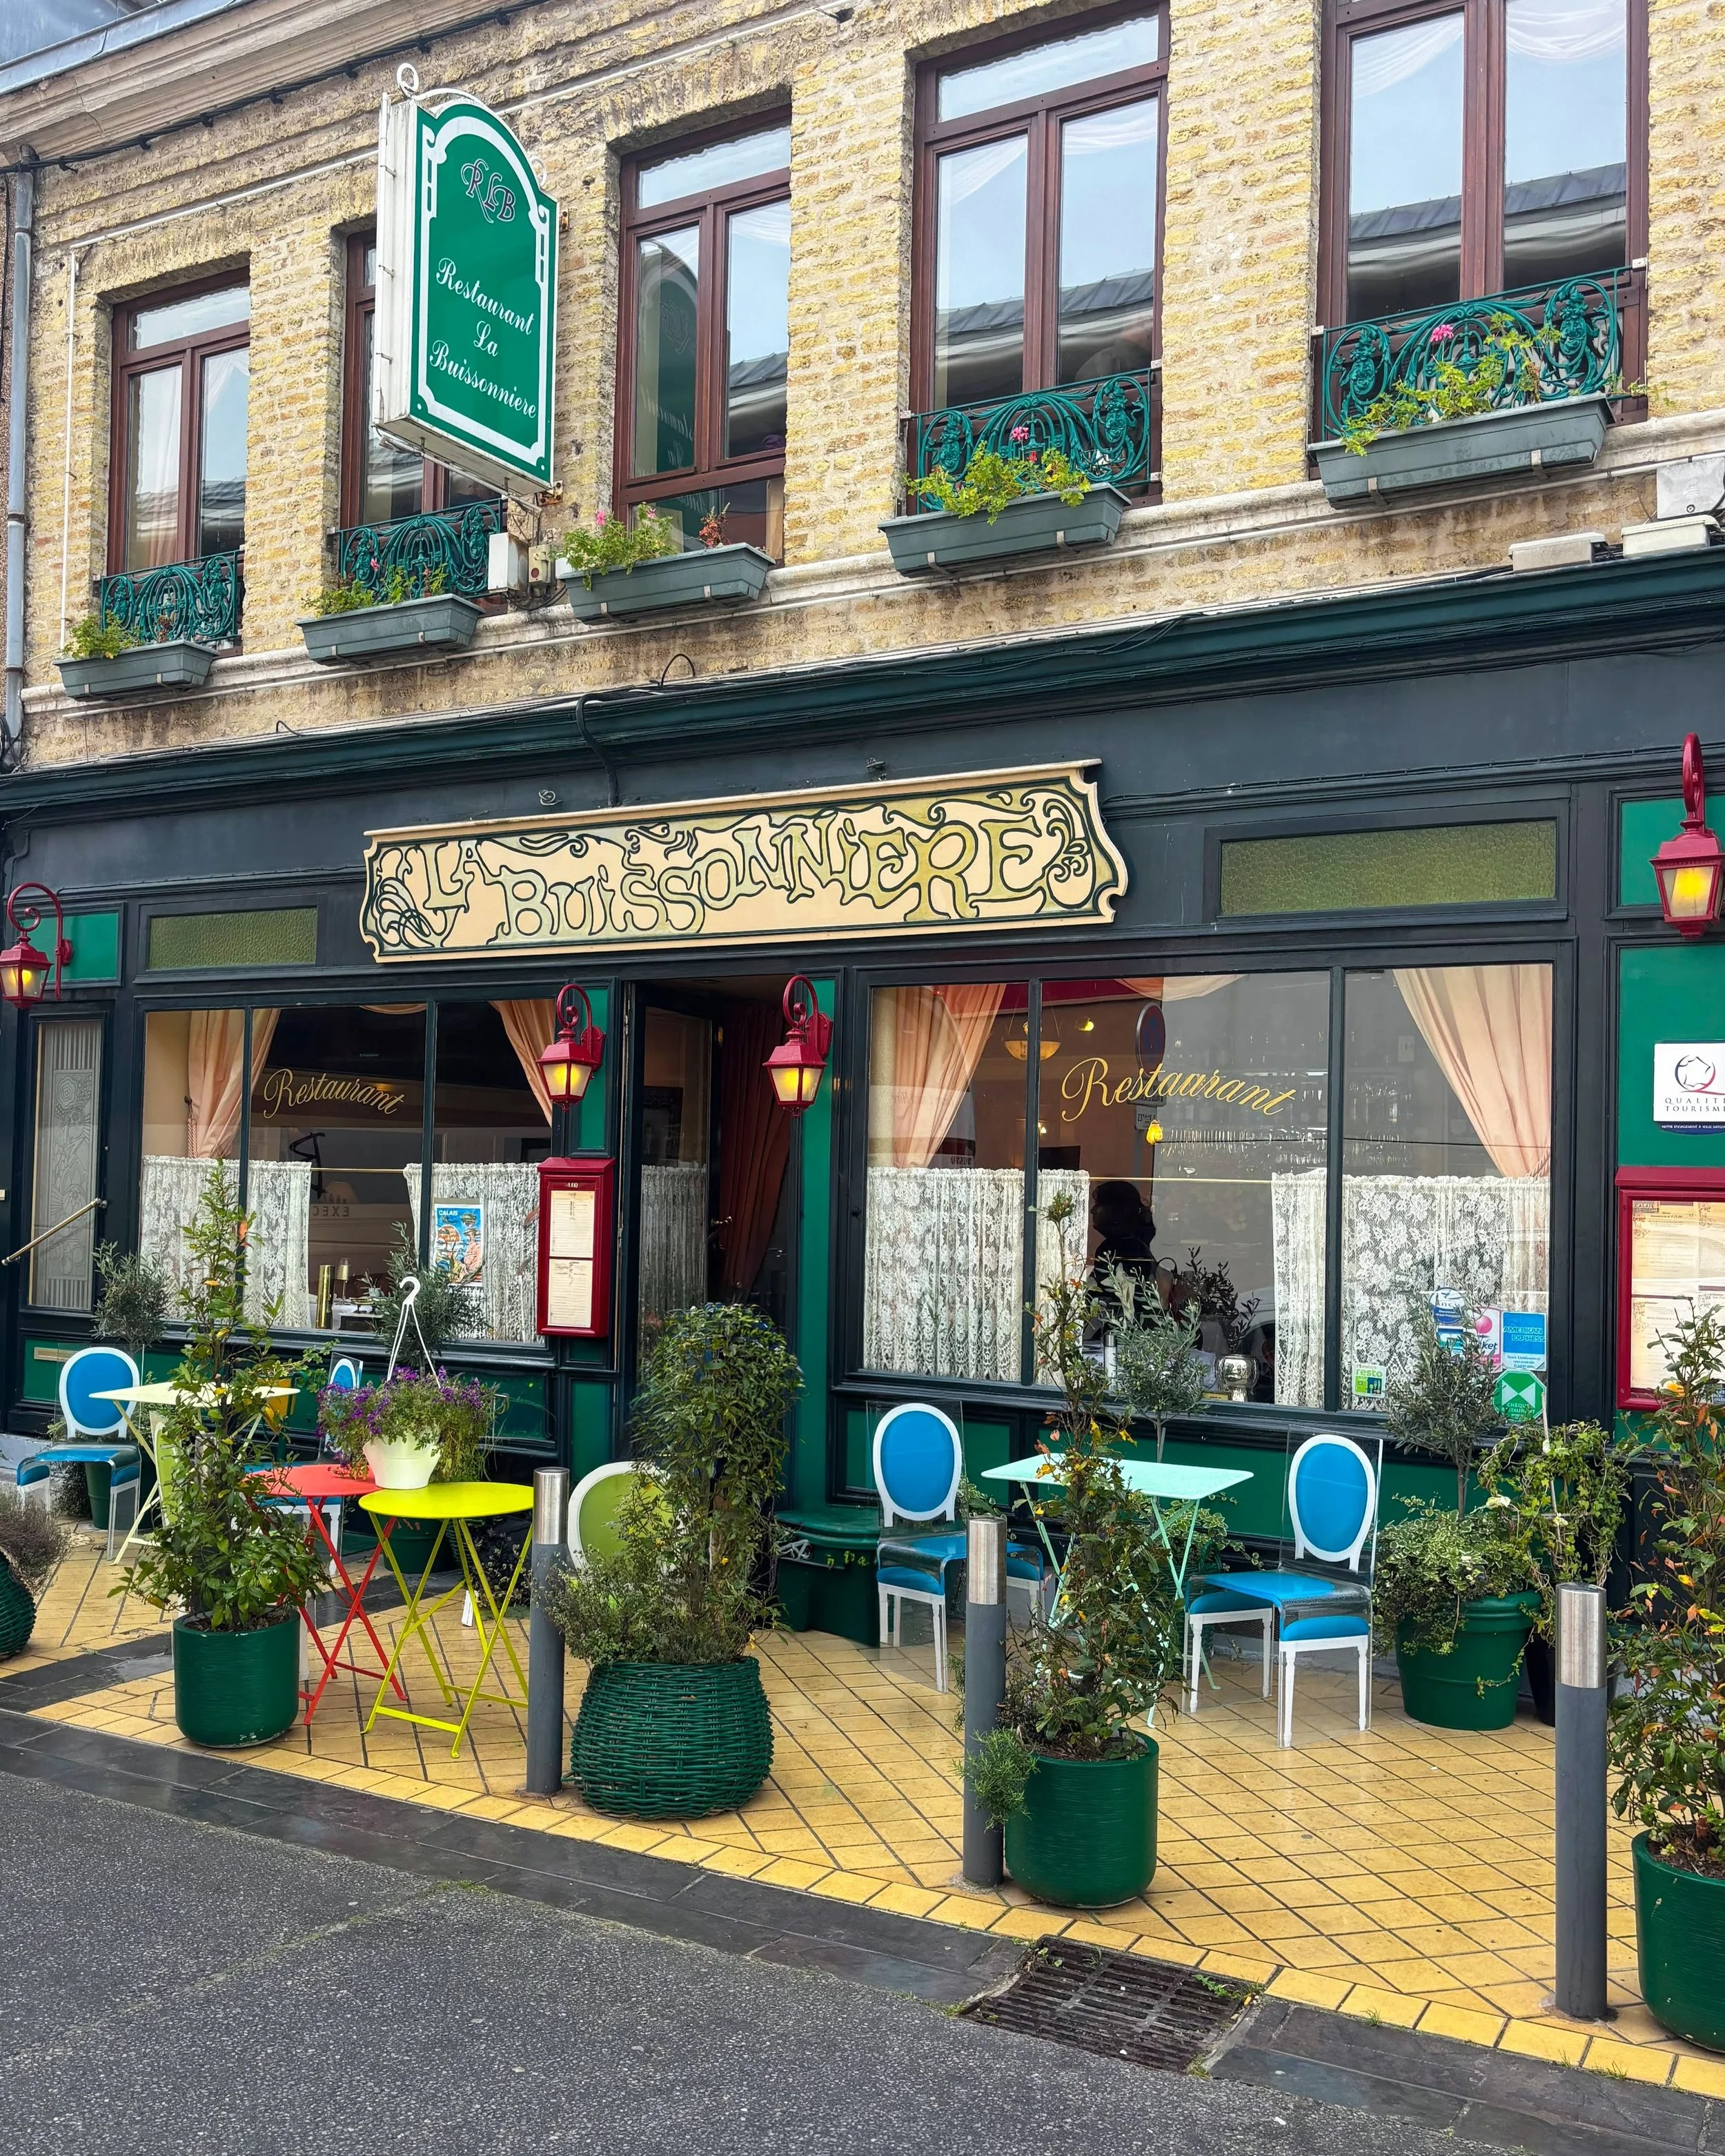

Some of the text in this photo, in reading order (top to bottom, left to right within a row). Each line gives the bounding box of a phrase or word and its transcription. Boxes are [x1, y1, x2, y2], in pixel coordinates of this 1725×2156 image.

[436, 257, 534, 335] Restaurant
[473, 320, 498, 357] La
[429, 339, 537, 418] Buissonniere
[404, 840, 487, 914] LA
[263, 1068, 406, 1119] Restaurant
[1061, 1057, 1297, 1122] Restaurant
[1504, 1326, 1544, 1334] AMERICAN
[1511, 1334, 1546, 1343] EXPRESS
[1356, 1369, 1383, 1378] resto
